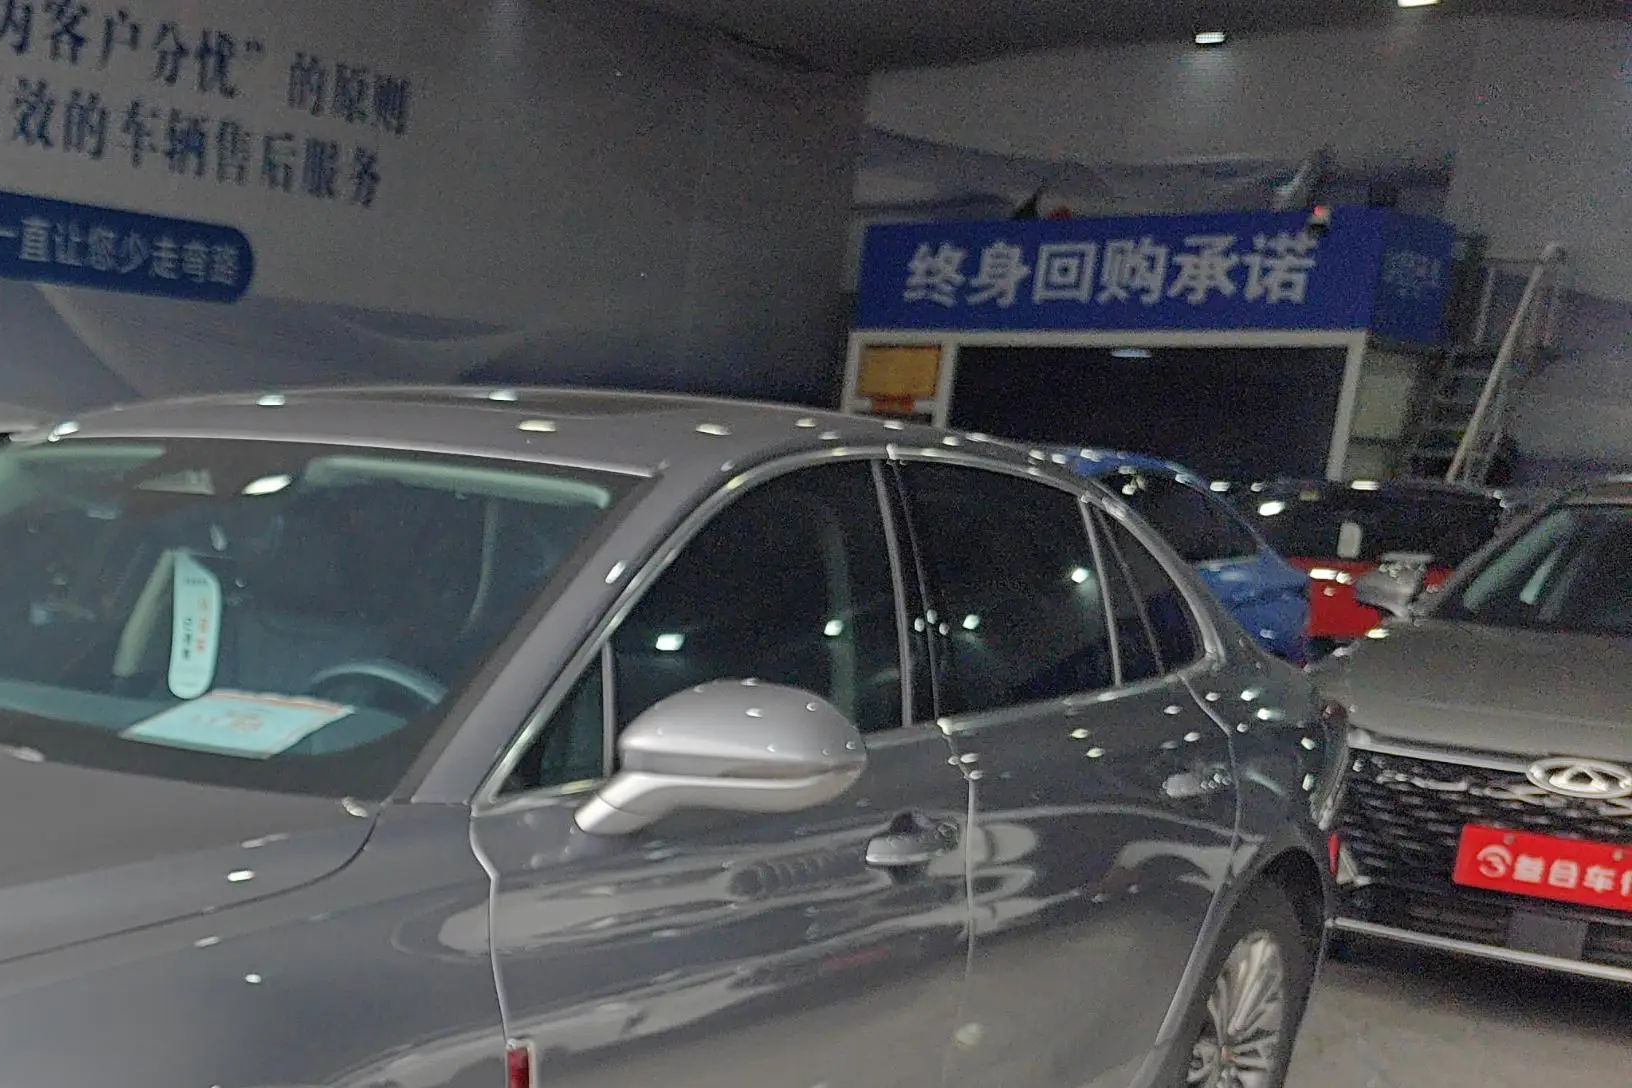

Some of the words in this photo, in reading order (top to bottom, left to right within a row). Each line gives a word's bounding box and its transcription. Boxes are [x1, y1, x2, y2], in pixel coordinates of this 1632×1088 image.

[903, 232, 1317, 309] 终身回购承诺
